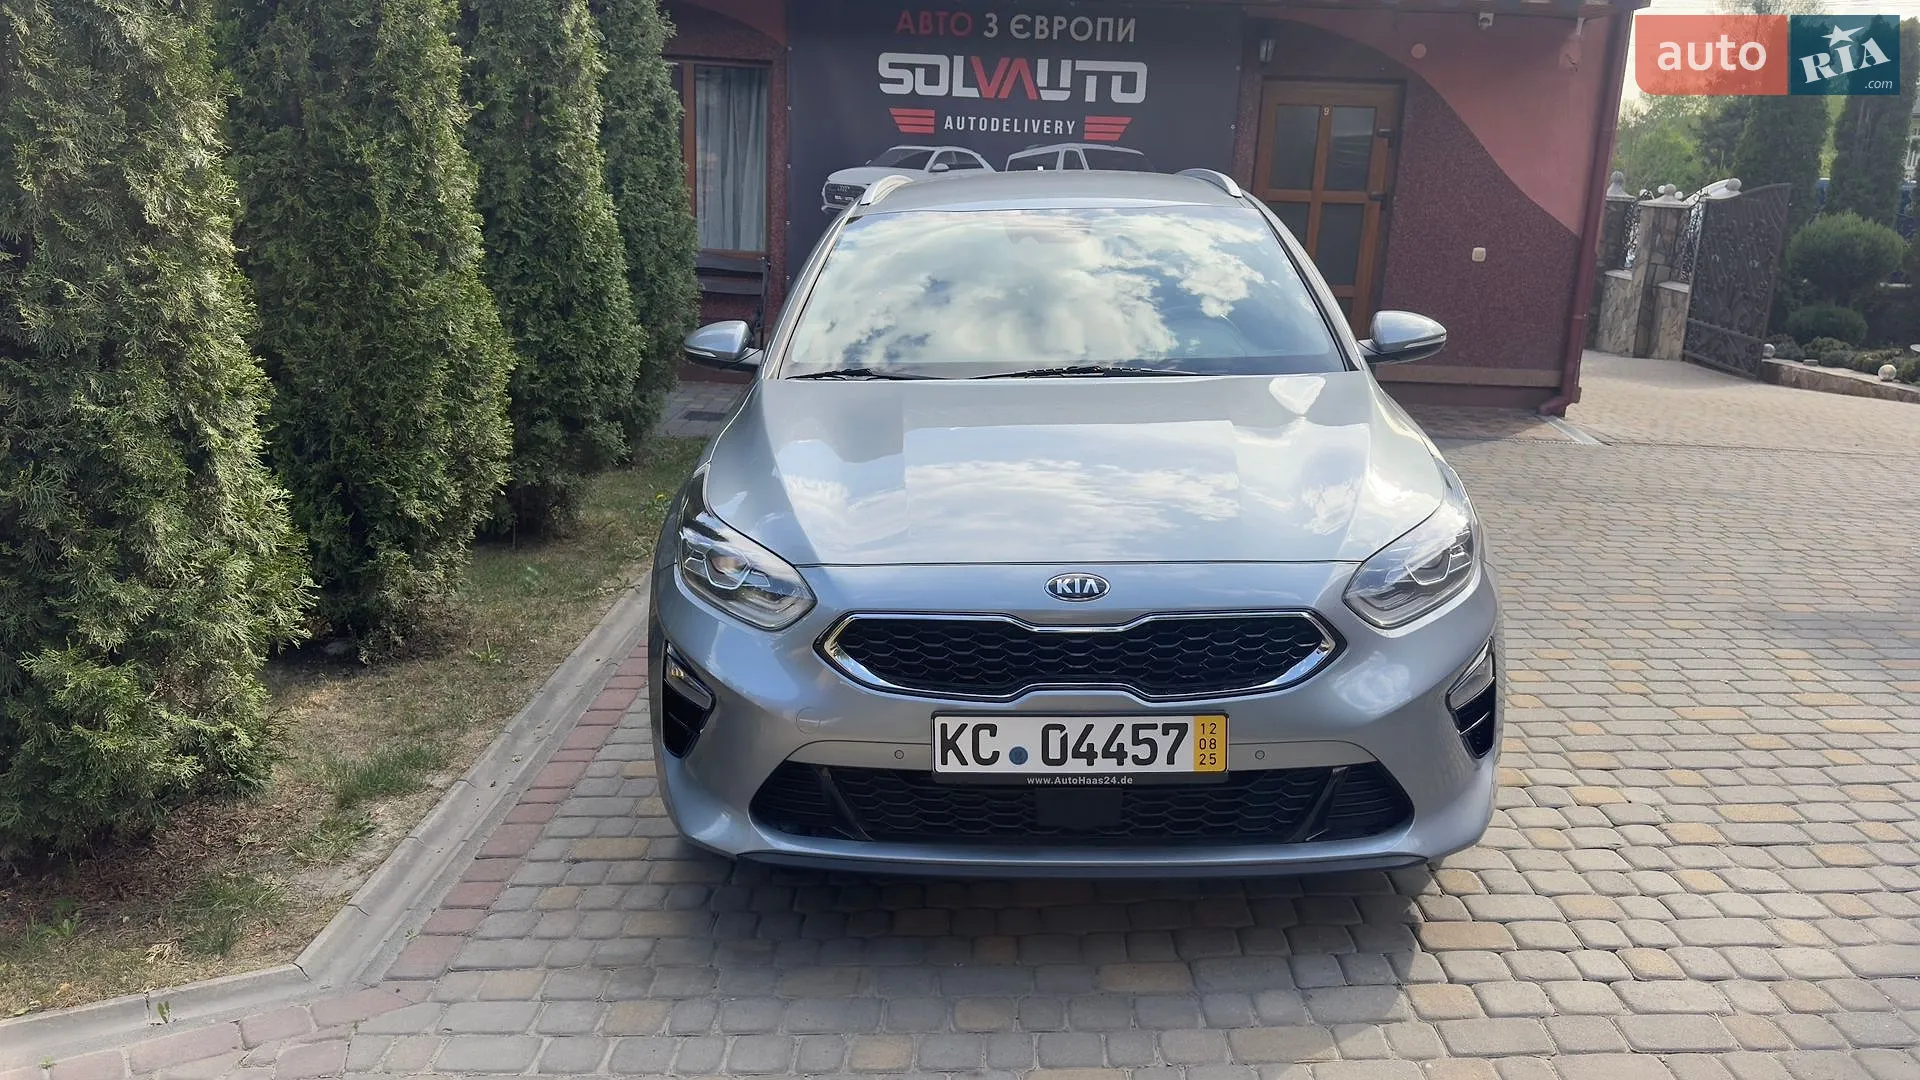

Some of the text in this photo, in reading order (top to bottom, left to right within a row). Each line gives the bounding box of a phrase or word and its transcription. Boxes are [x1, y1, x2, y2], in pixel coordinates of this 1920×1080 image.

[896, 10, 973, 37] АВТО
[1009, 14, 1136, 42] ЄВРОПИ
[878, 52, 1147, 104] SOLVAUTO
[944, 115, 1076, 135] AUTODELIVERY
[1056, 578, 1100, 593] KIA
[1200, 722, 1217, 735] 12
[940, 722, 1189, 767] KC 04457
[1199, 738, 1217, 750] 08
[1199, 753, 1217, 766] 25
[1026, 776, 1133, 785] www.AutoHaas24.de
